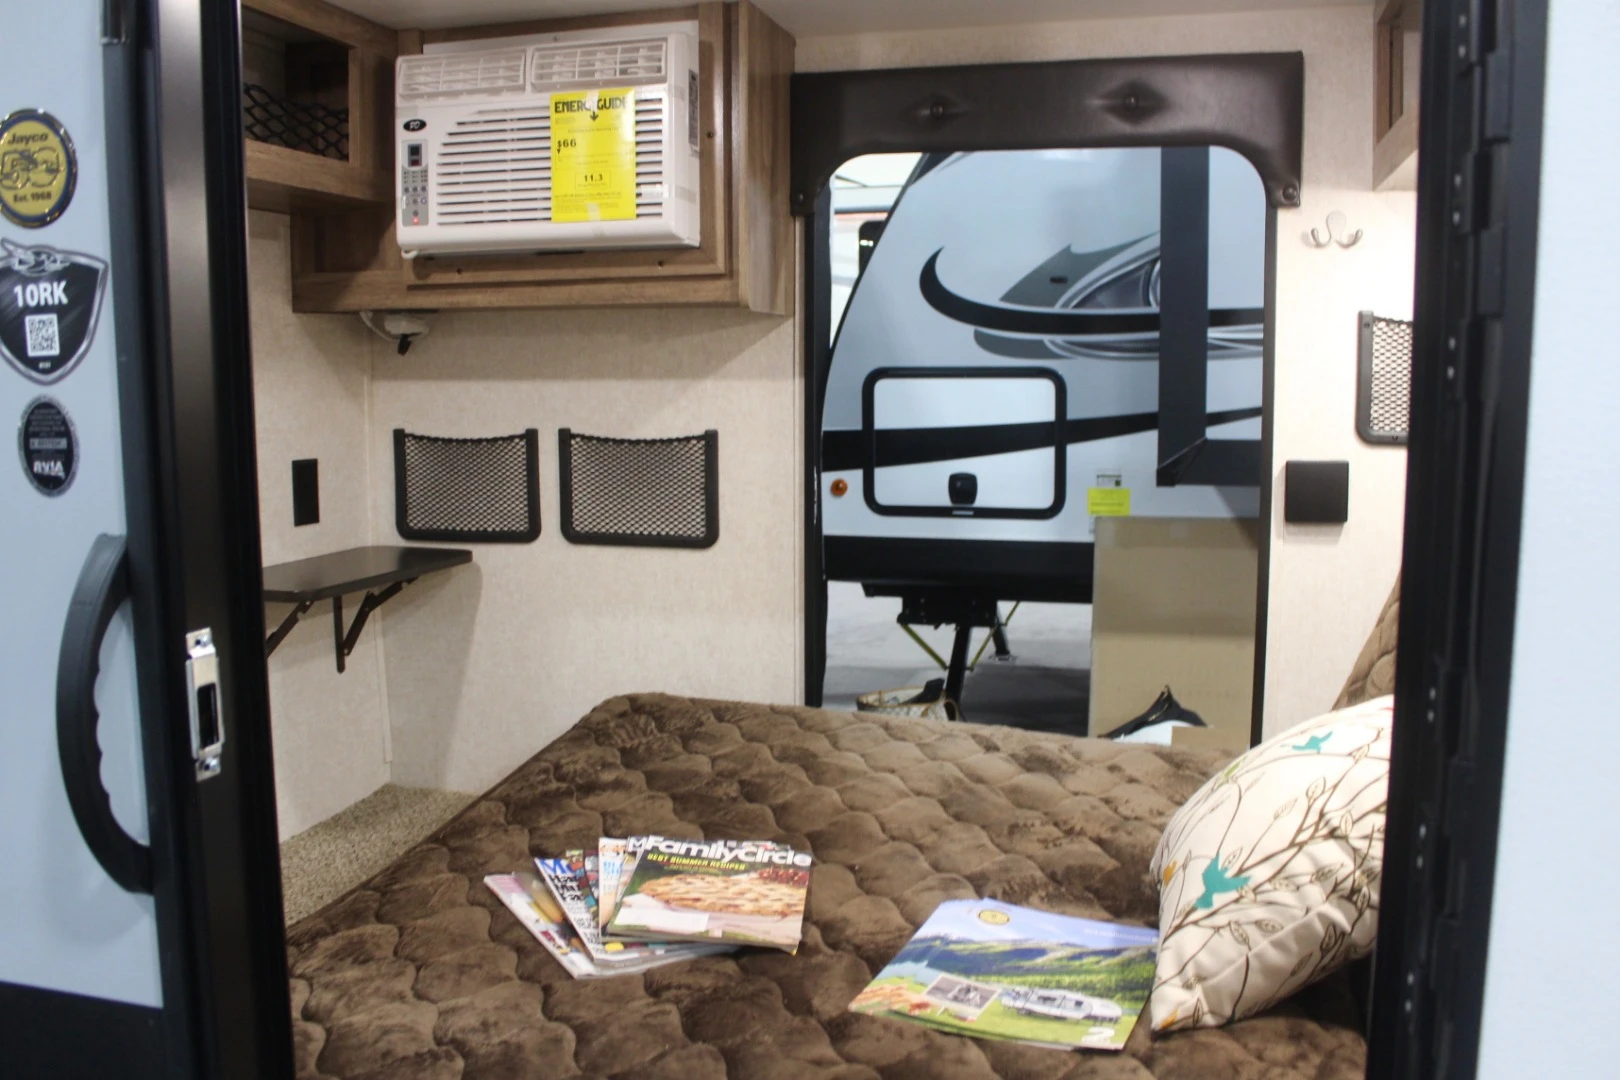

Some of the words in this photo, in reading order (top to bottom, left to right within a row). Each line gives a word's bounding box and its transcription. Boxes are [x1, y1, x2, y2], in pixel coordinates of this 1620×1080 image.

[8, 133, 48, 145] Jayco
[557, 138, 576, 149] $66
[584, 173, 603, 182] 11.3
[14, 280, 69, 308] 10RK
[33, 460, 65, 477] RVIA
